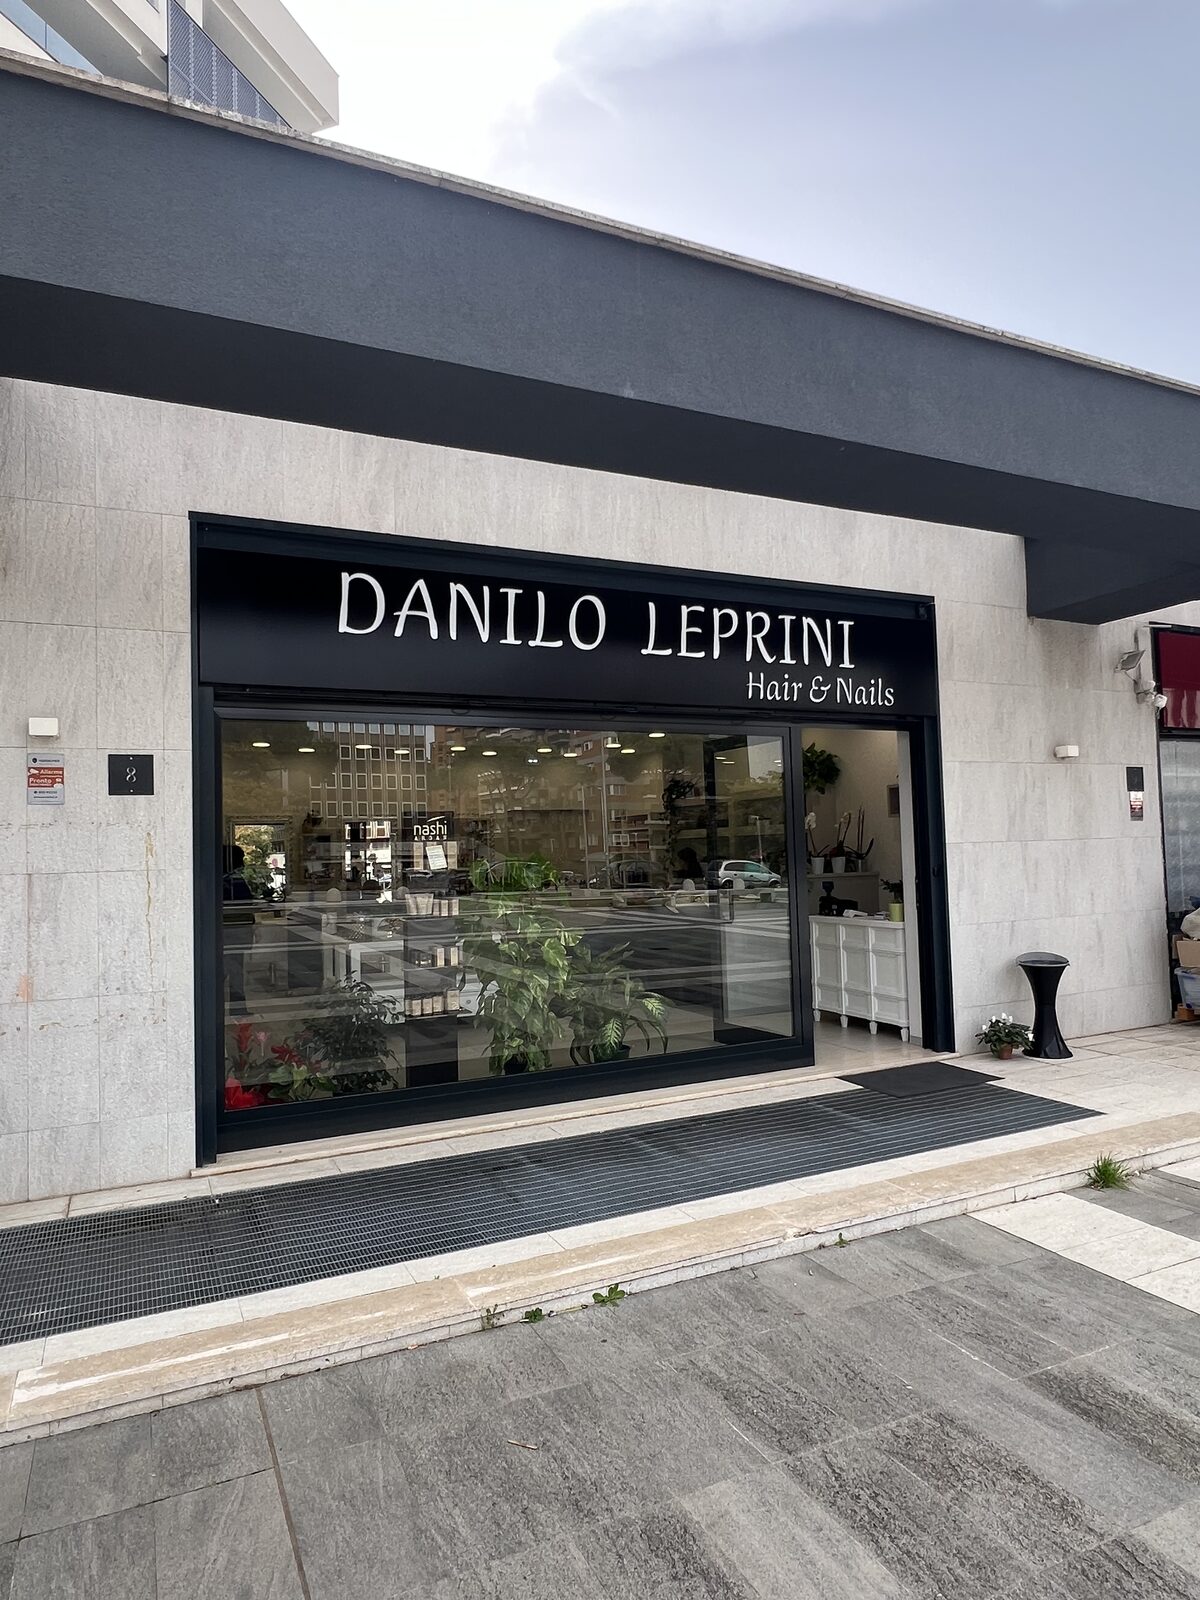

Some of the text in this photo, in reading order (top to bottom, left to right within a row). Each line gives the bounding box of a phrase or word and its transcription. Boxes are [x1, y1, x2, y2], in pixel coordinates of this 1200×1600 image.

[338, 571, 855, 671] DANILO LEPRINI
[746, 671, 895, 707] Hair & Nails
[126, 766, 137, 783] 8
[413, 820, 447, 836] nashi
